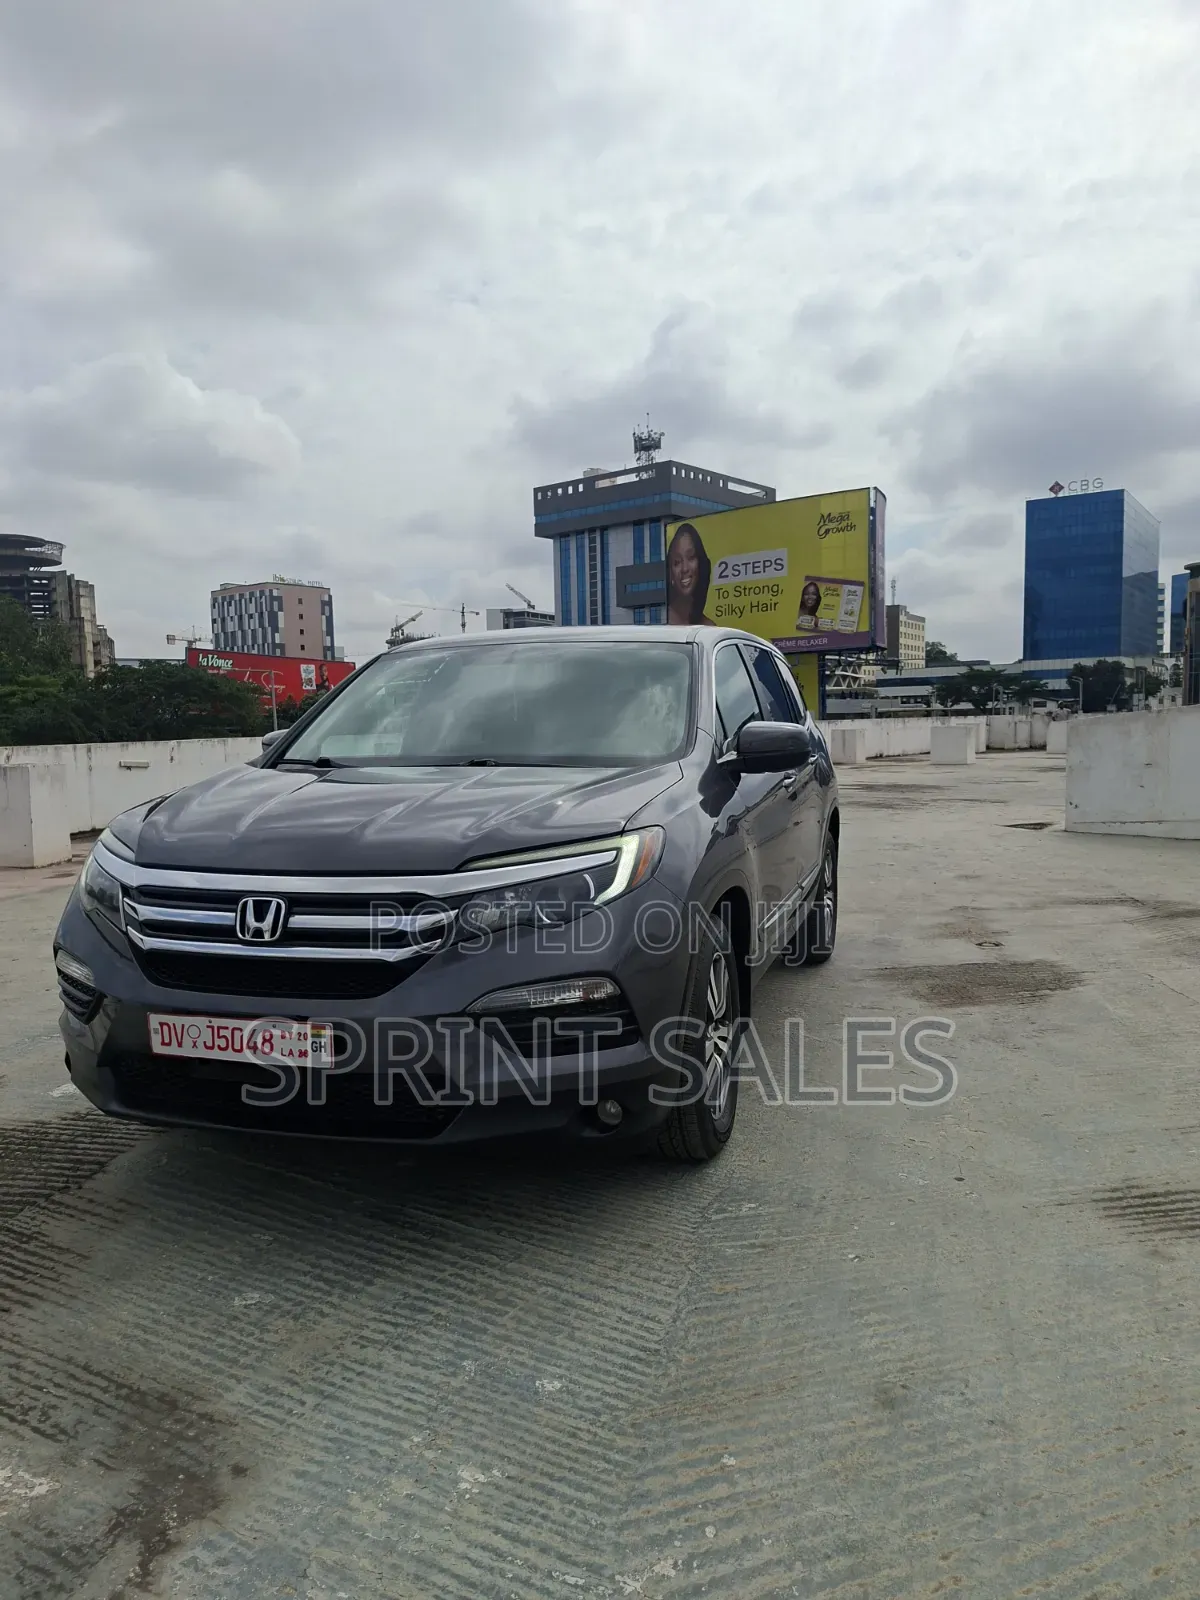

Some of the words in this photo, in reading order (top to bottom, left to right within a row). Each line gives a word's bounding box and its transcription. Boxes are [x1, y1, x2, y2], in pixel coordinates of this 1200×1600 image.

[1068, 478, 1103, 491] CBG
[817, 512, 850, 526] Mega
[817, 522, 856, 539] Growth
[718, 561, 729, 579] 2
[731, 558, 784, 577] STEPS
[715, 588, 729, 600] To
[733, 584, 783, 598] Strong,
[715, 604, 745, 618] Silky
[750, 599, 779, 613] Hair
[797, 638, 828, 647] RELAXER
[159, 1021, 185, 1048] DV
[203, 1024, 274, 1056] J5048
[280, 1047, 294, 1058] LA
[311, 1041, 326, 1054] GH
